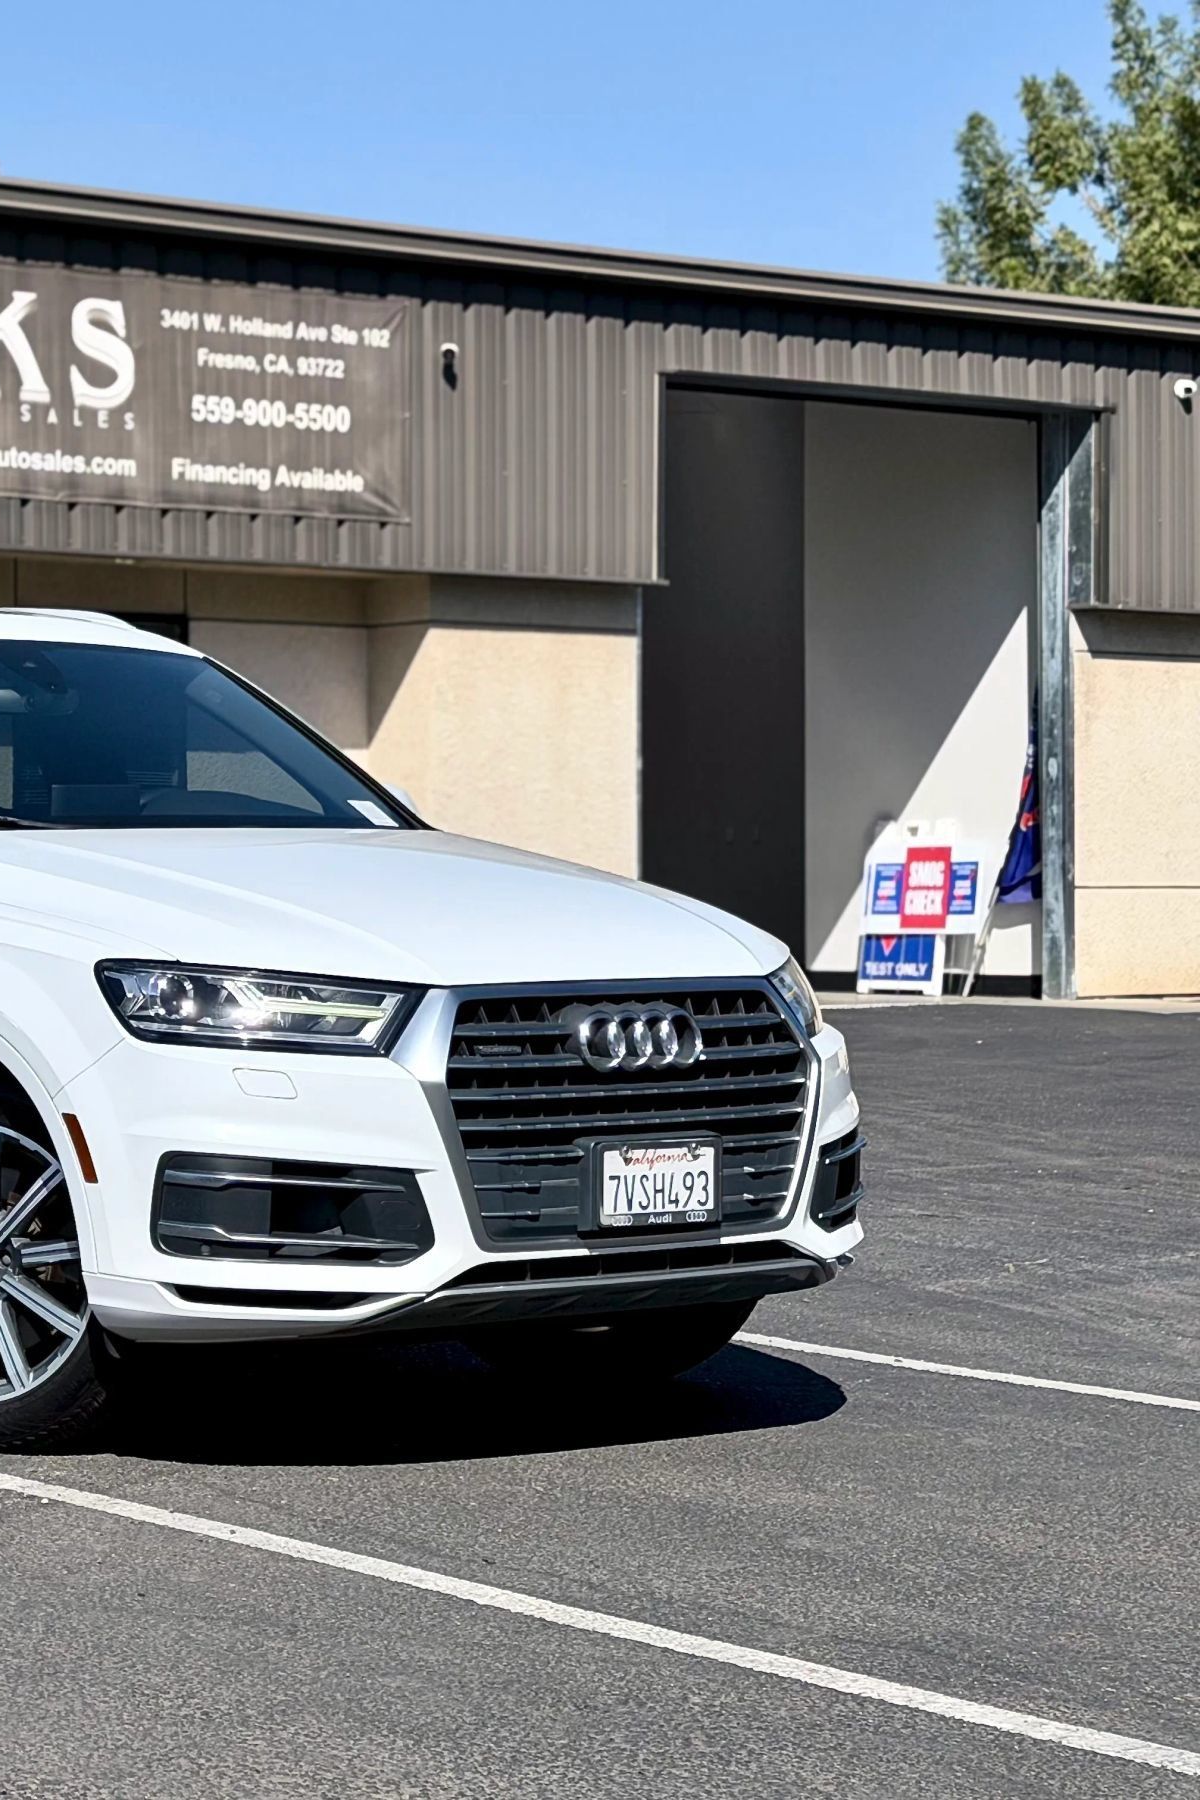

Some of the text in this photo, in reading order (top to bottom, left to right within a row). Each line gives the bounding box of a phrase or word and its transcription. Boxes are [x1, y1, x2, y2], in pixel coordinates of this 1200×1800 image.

[203, 313, 226, 333] W.
[229, 315, 293, 340] Holland
[296, 322, 328, 342] Ave
[331, 324, 358, 346] Ste
[197, 348, 345, 379] Fresno, CA, 93722
[20, 403, 136, 431] SALES
[191, 394, 351, 433] 559-900-5500
[171, 457, 365, 493] Financing Available
[865, 961, 894, 976] TEST
[625, 1147, 695, 1171] alifornia
[608, 1170, 709, 1213] 7VSH493
[647, 1213, 673, 1224] Audi
